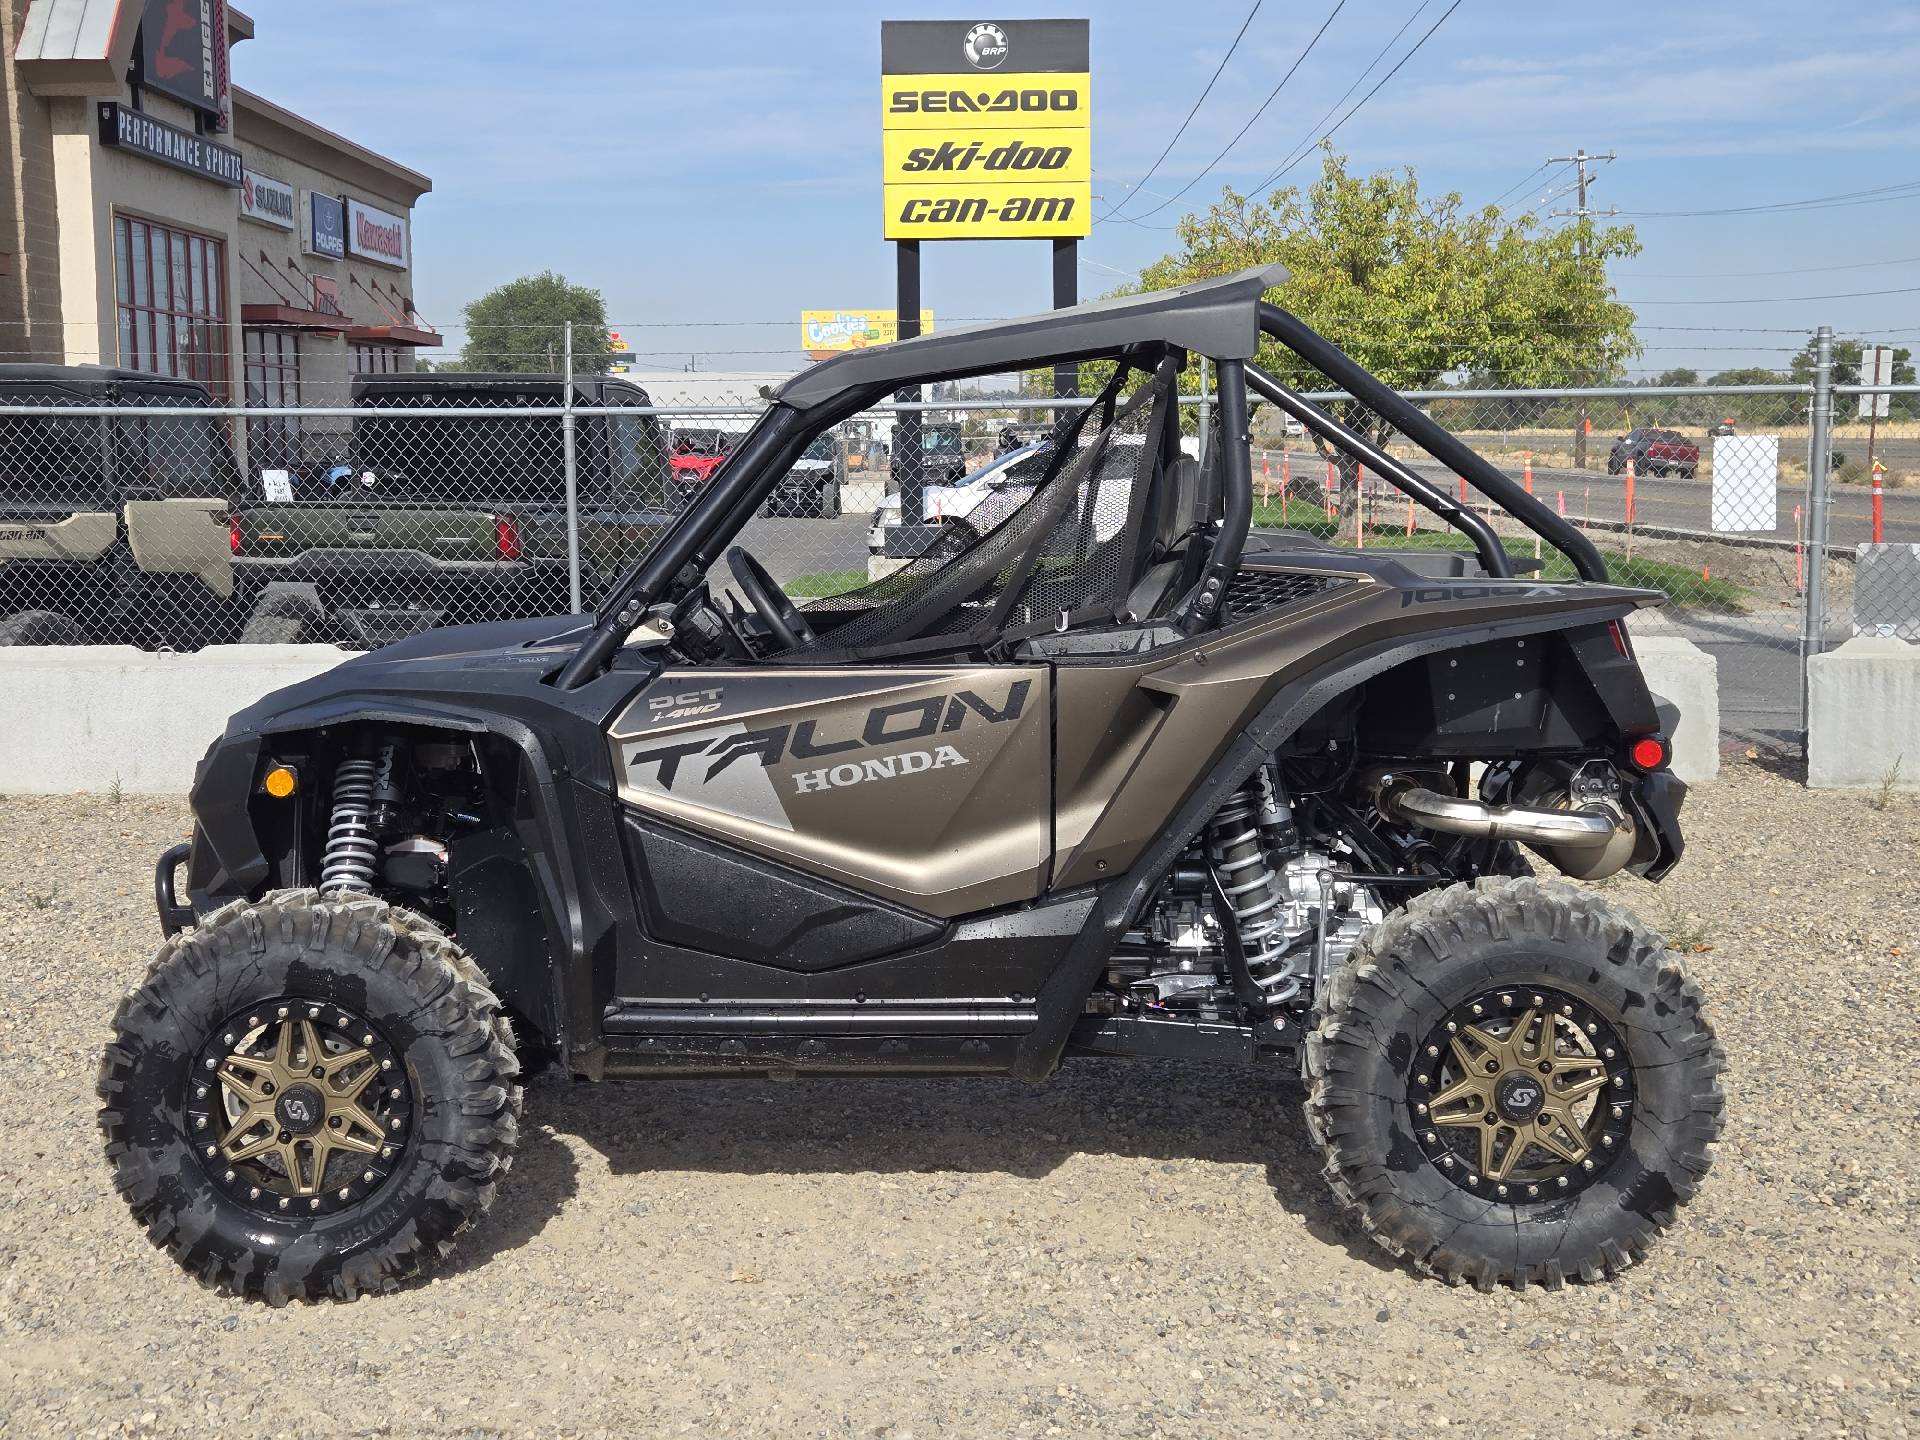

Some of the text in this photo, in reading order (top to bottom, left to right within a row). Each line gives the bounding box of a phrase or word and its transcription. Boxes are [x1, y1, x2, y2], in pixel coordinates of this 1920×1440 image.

[981, 47, 1007, 56] BRP
[119, 110, 241, 181] PERFORMANCE SPORTS
[901, 140, 1073, 172] ski-doo
[255, 184, 293, 221] SUZUKI
[900, 197, 1075, 223] can-am
[316, 231, 344, 253] POLARIS
[356, 210, 403, 260] Kawasaki
[808, 312, 868, 342] Cookies
[648, 687, 724, 710] DCT
[629, 678, 1033, 792] TALON
[791, 744, 970, 796] HONDA
